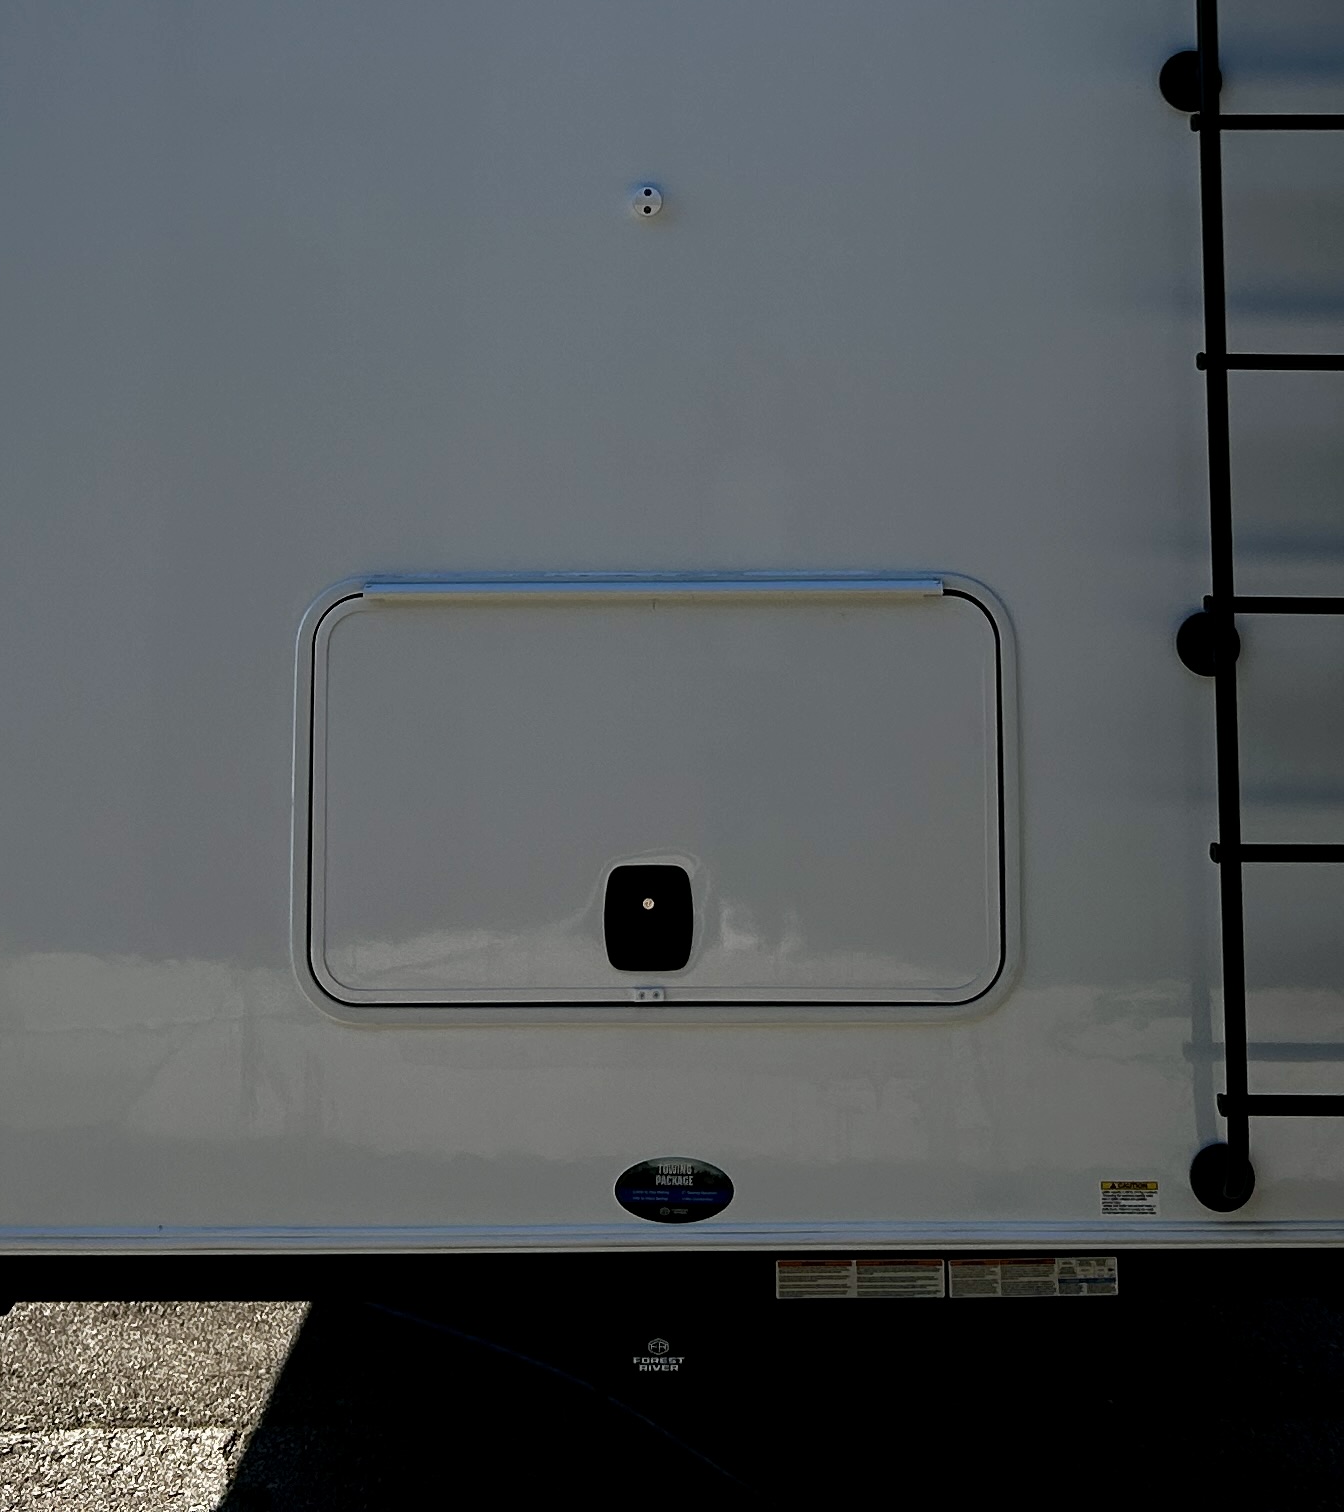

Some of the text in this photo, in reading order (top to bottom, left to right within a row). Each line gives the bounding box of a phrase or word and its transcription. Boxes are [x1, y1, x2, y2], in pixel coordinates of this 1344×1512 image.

[655, 1175, 694, 1186] PACKAGE
[632, 1356, 686, 1364] FOREST
[638, 1364, 679, 1372] RIVER
